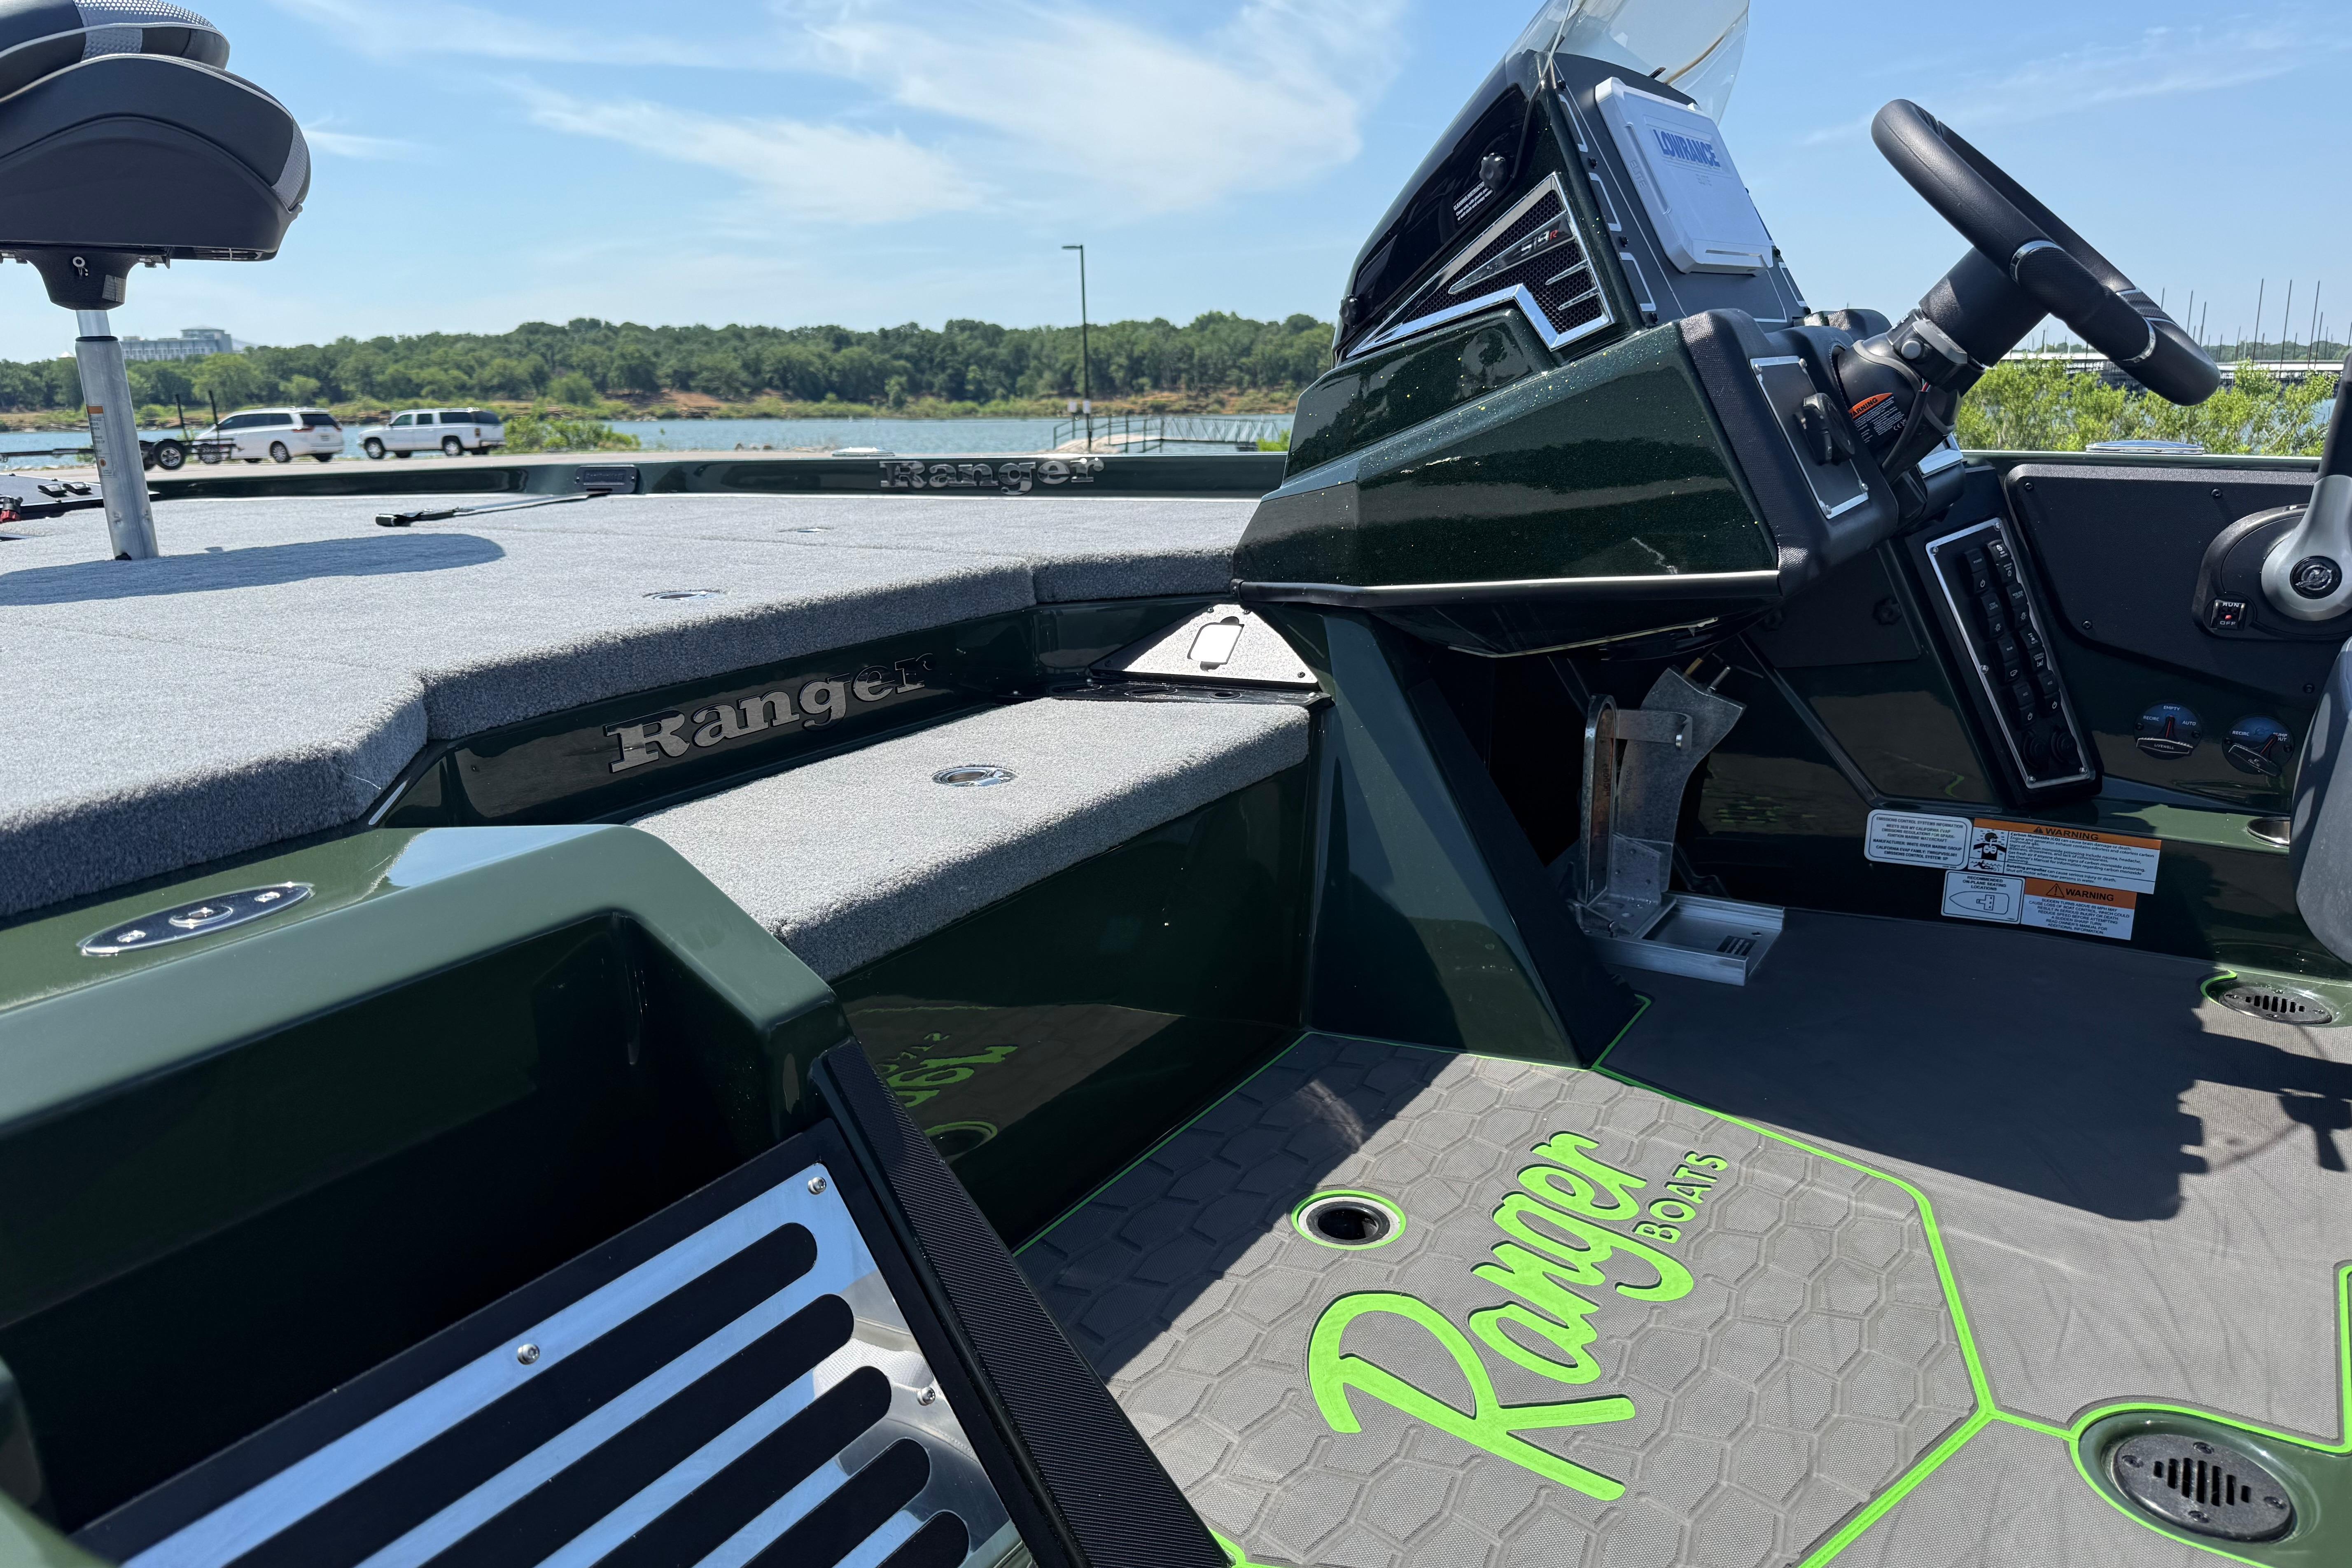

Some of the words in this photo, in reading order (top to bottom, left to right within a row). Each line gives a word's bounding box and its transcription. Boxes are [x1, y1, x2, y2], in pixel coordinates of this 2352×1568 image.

[1653, 129, 1720, 167] LOWRANCE
[1467, 182, 1484, 198] INSTRUCTIO
[1630, 160, 1647, 188] ELITE
[879, 457, 1104, 496] Ranger
[604, 652, 936, 773] Ranger
[2045, 828, 2098, 840] WARNING
[2066, 888, 2114, 901] WARNING
[1307, 1131, 1694, 1502] Ranger
[1634, 1150, 1730, 1244] BOATS
